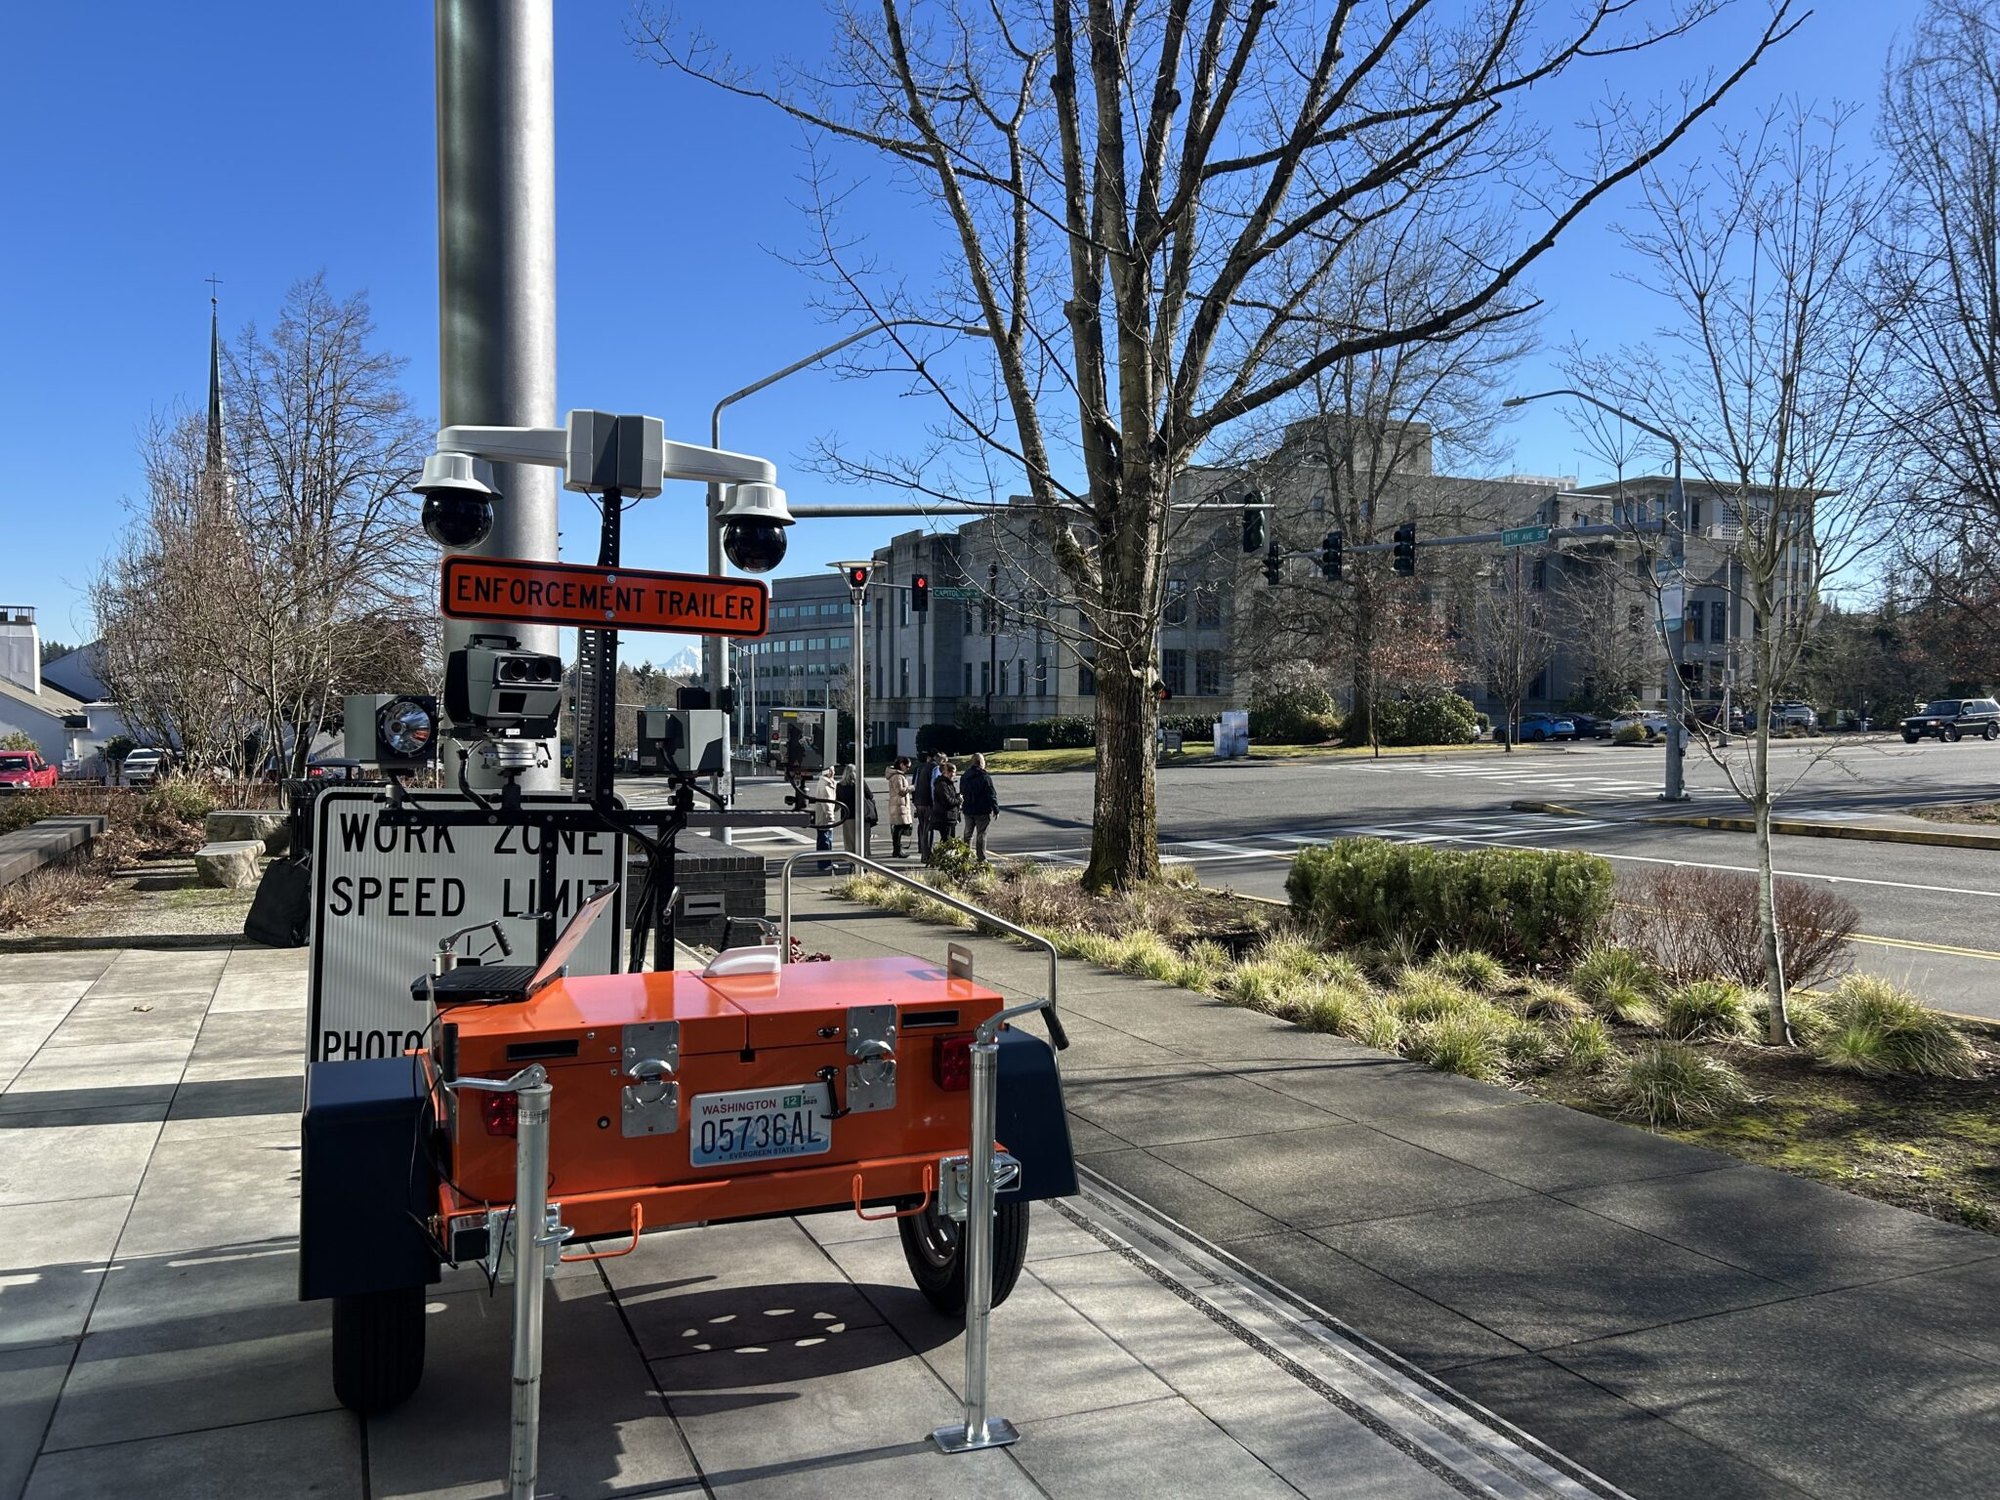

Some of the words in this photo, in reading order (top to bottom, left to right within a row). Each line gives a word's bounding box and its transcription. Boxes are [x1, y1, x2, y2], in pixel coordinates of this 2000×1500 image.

[1522, 532, 1533, 541] AVE
[457, 575, 646, 613] ENFORCEMENT
[655, 590, 755, 621] TRAILER
[340, 813, 455, 854] WORK
[330, 876, 466, 917] SPEED
[323, 1030, 424, 1062] PHOTO
[702, 1099, 776, 1116] WASHINGTON
[784, 1096, 798, 1106] 12
[701, 1110, 822, 1154] 05736AL
[729, 1148, 772, 1160] EVERGREEN
[773, 1146, 795, 1157] STATE
